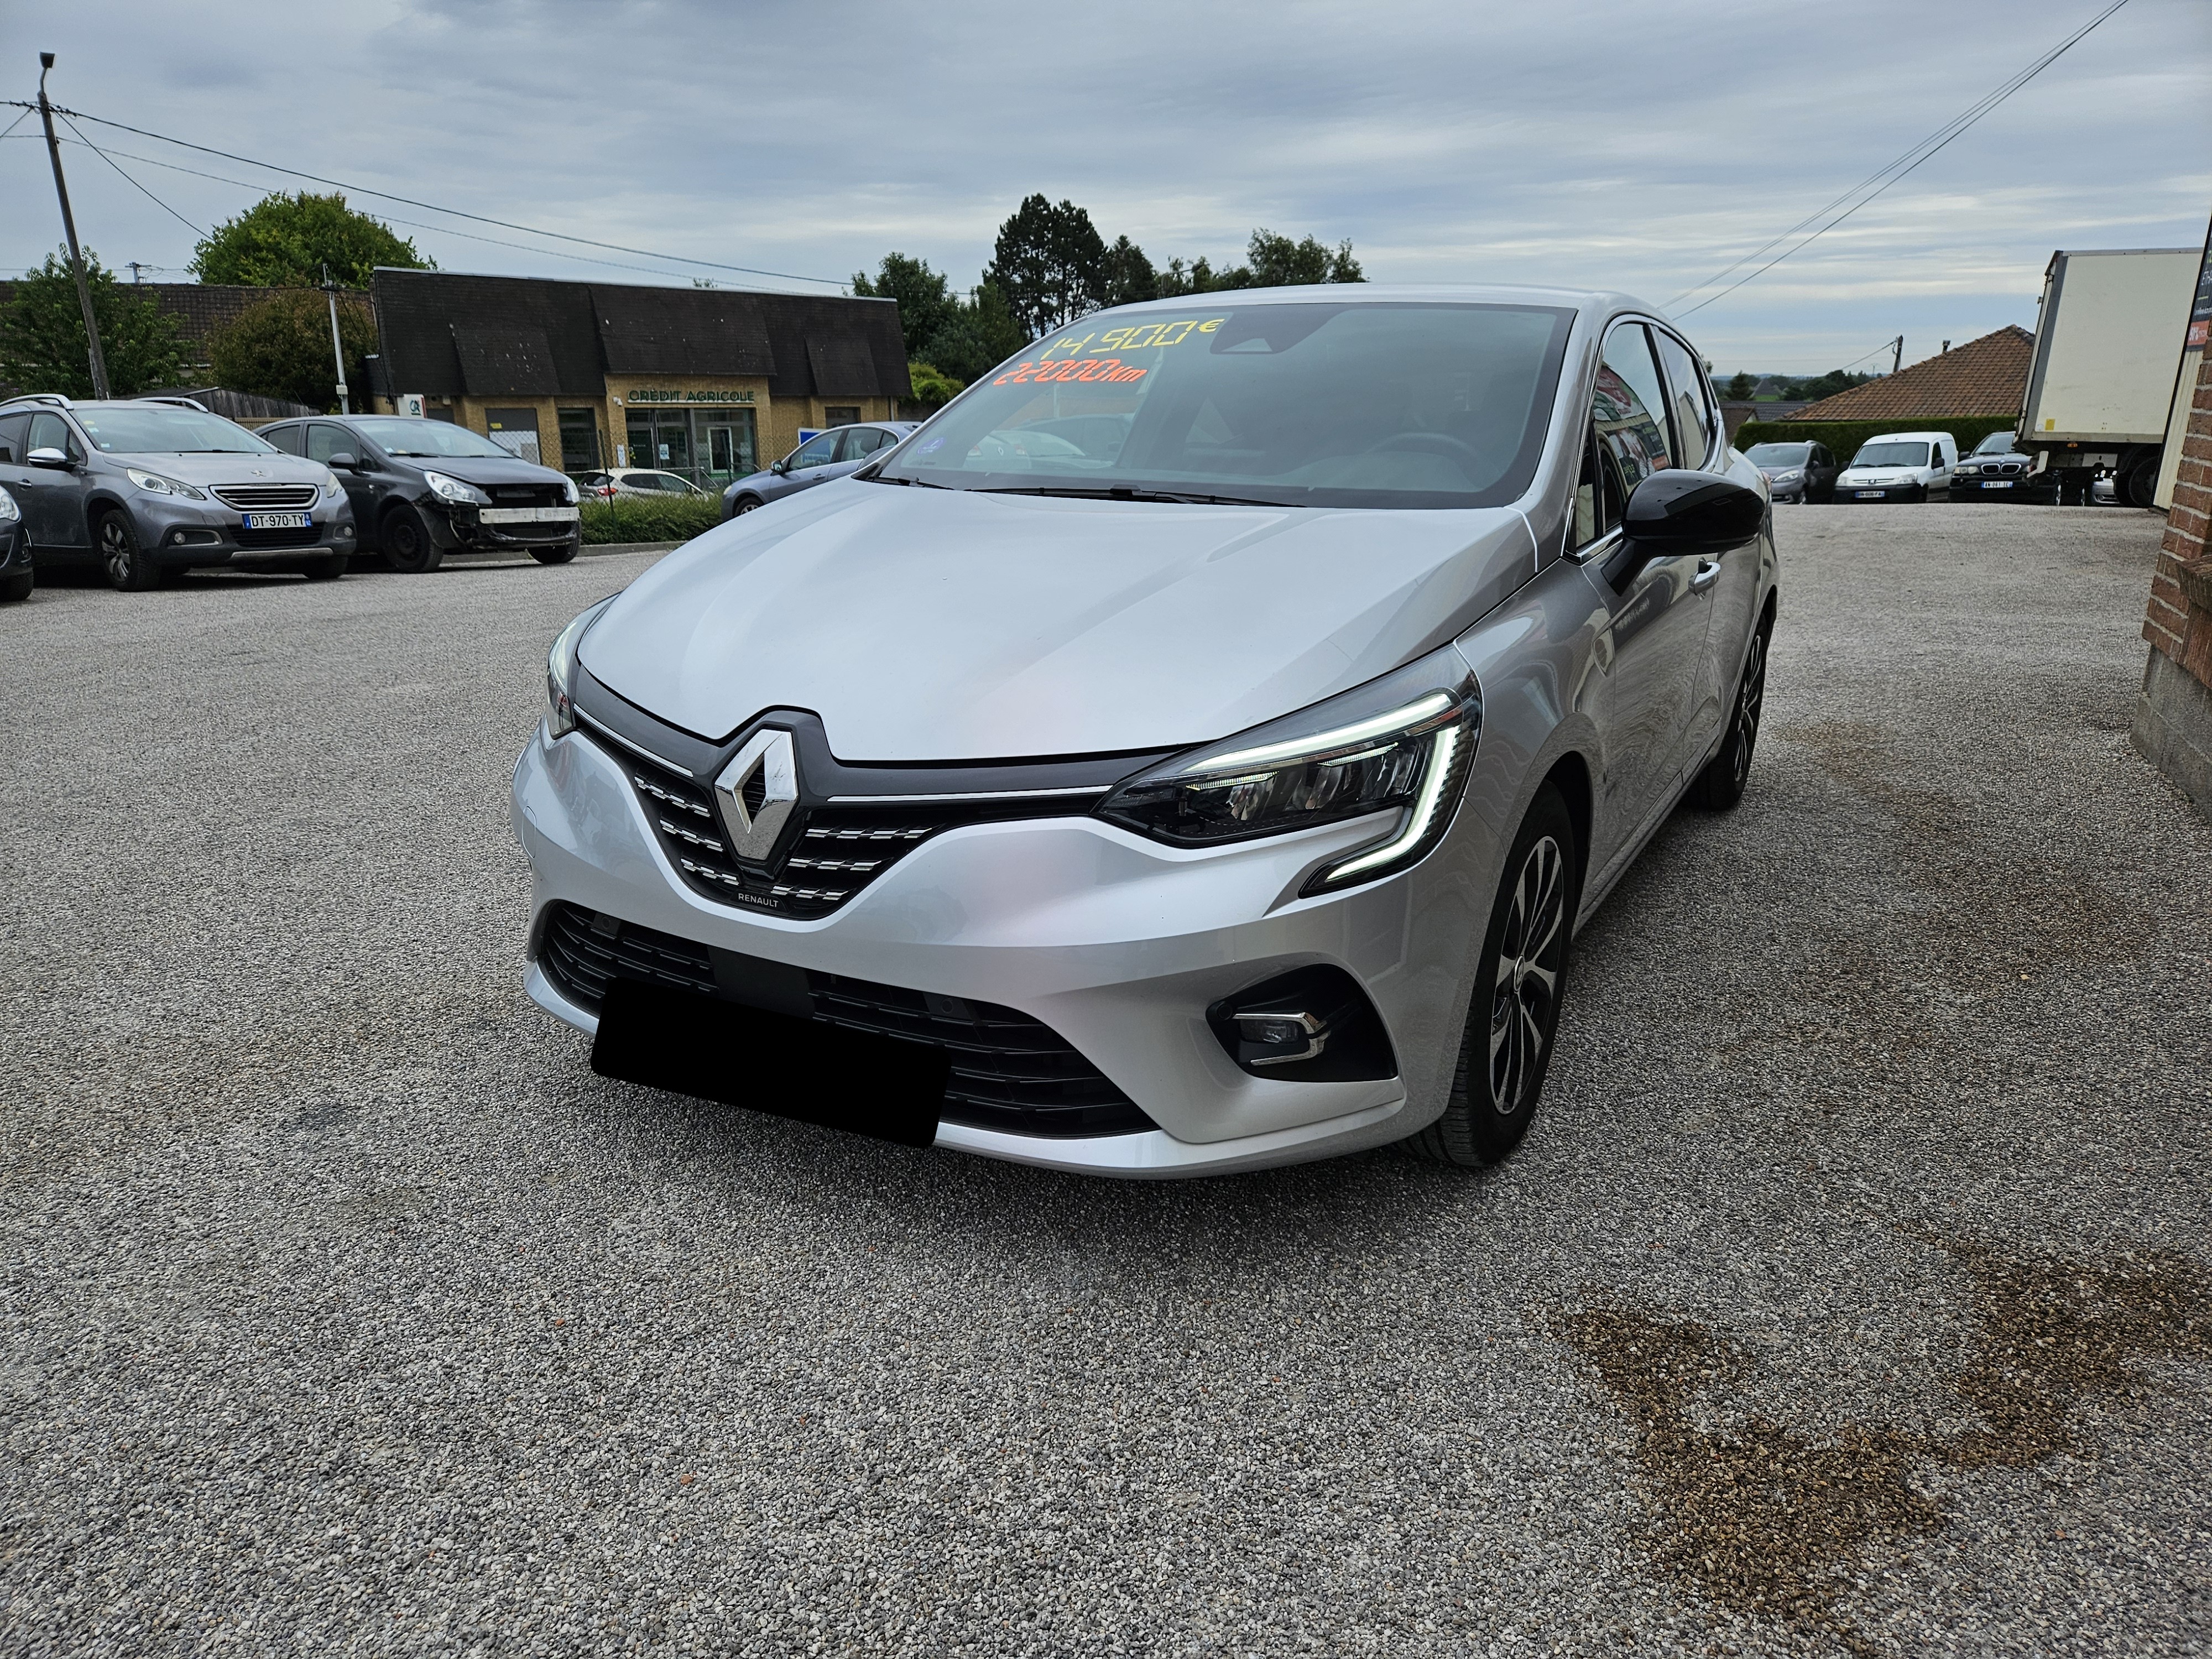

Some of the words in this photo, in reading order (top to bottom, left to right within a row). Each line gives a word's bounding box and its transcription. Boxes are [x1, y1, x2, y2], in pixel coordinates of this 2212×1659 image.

[1041, 332, 1095, 360] 14
[1089, 319, 1225, 353] 900€
[628, 389, 681, 401] CRÉDIT
[686, 390, 754, 402] AGRICOLE
[251, 515, 304, 526] DT-970-TY
[738, 893, 779, 907] RENAULT
